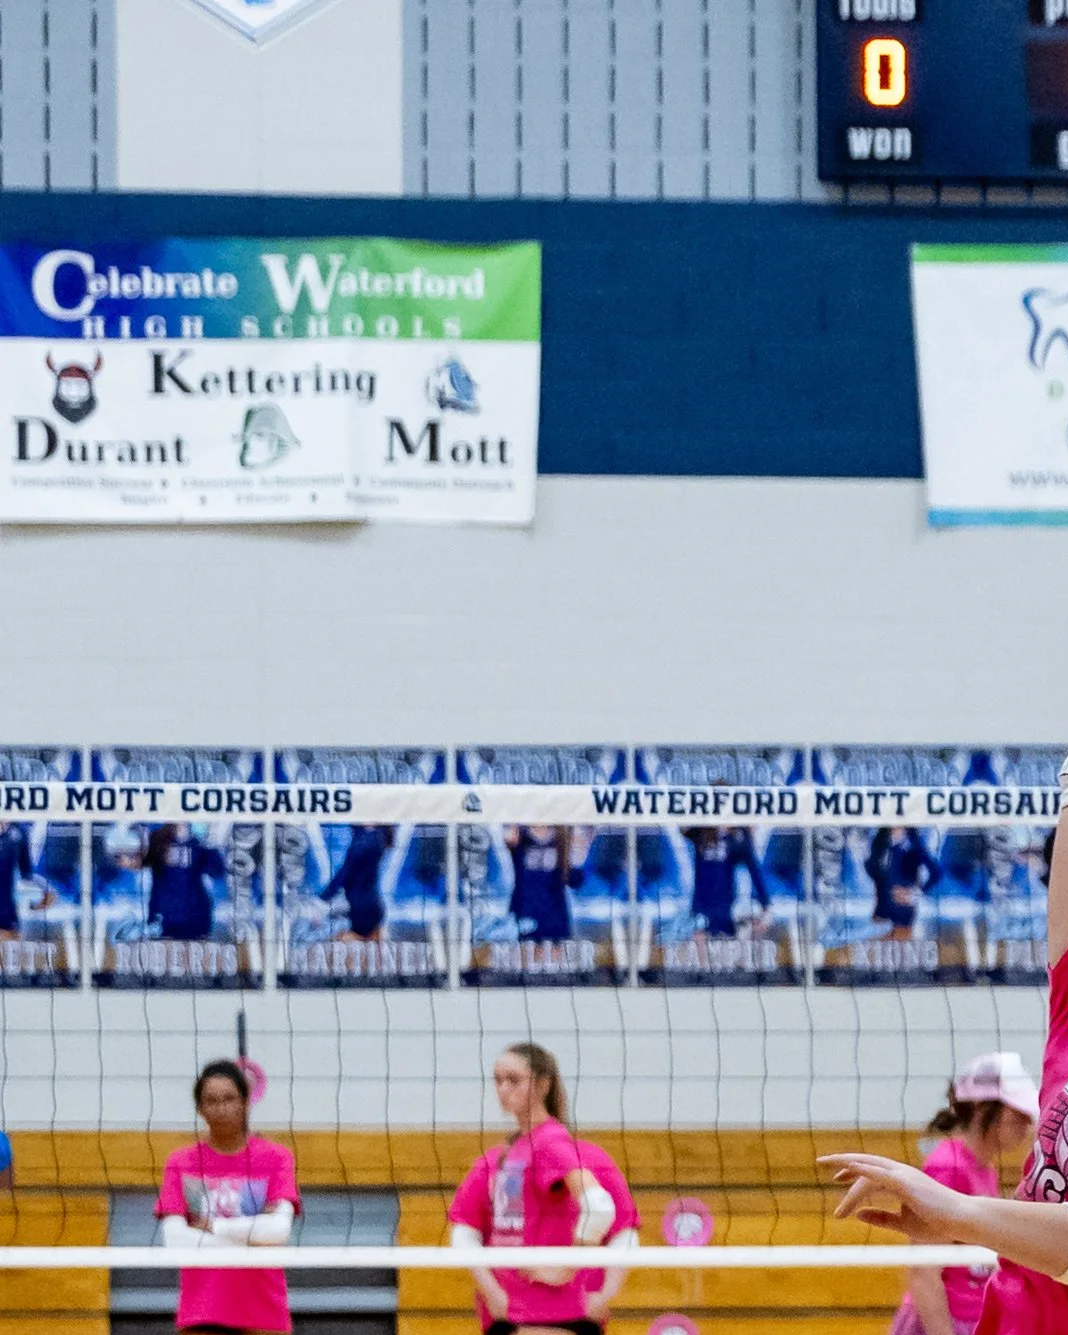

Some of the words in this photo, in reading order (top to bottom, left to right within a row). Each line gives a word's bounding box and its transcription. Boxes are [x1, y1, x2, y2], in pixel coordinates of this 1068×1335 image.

[862, 37, 907, 107] 0
[848, 127, 912, 161] won
[31, 249, 239, 322] Celebrate
[259, 253, 486, 315] Waterford
[82, 315, 204, 339] HIGH
[240, 313, 463, 339] SCHOOLS
[148, 349, 378, 405] Kettering
[12, 415, 189, 466] Durant
[384, 416, 516, 468] Mott
[0, 786, 48, 811] RD
[66, 787, 164, 811] MOTT
[181, 788, 353, 813] CORSAIRS
[592, 789, 797, 815] WATERFORD
[814, 791, 910, 816] MOTT
